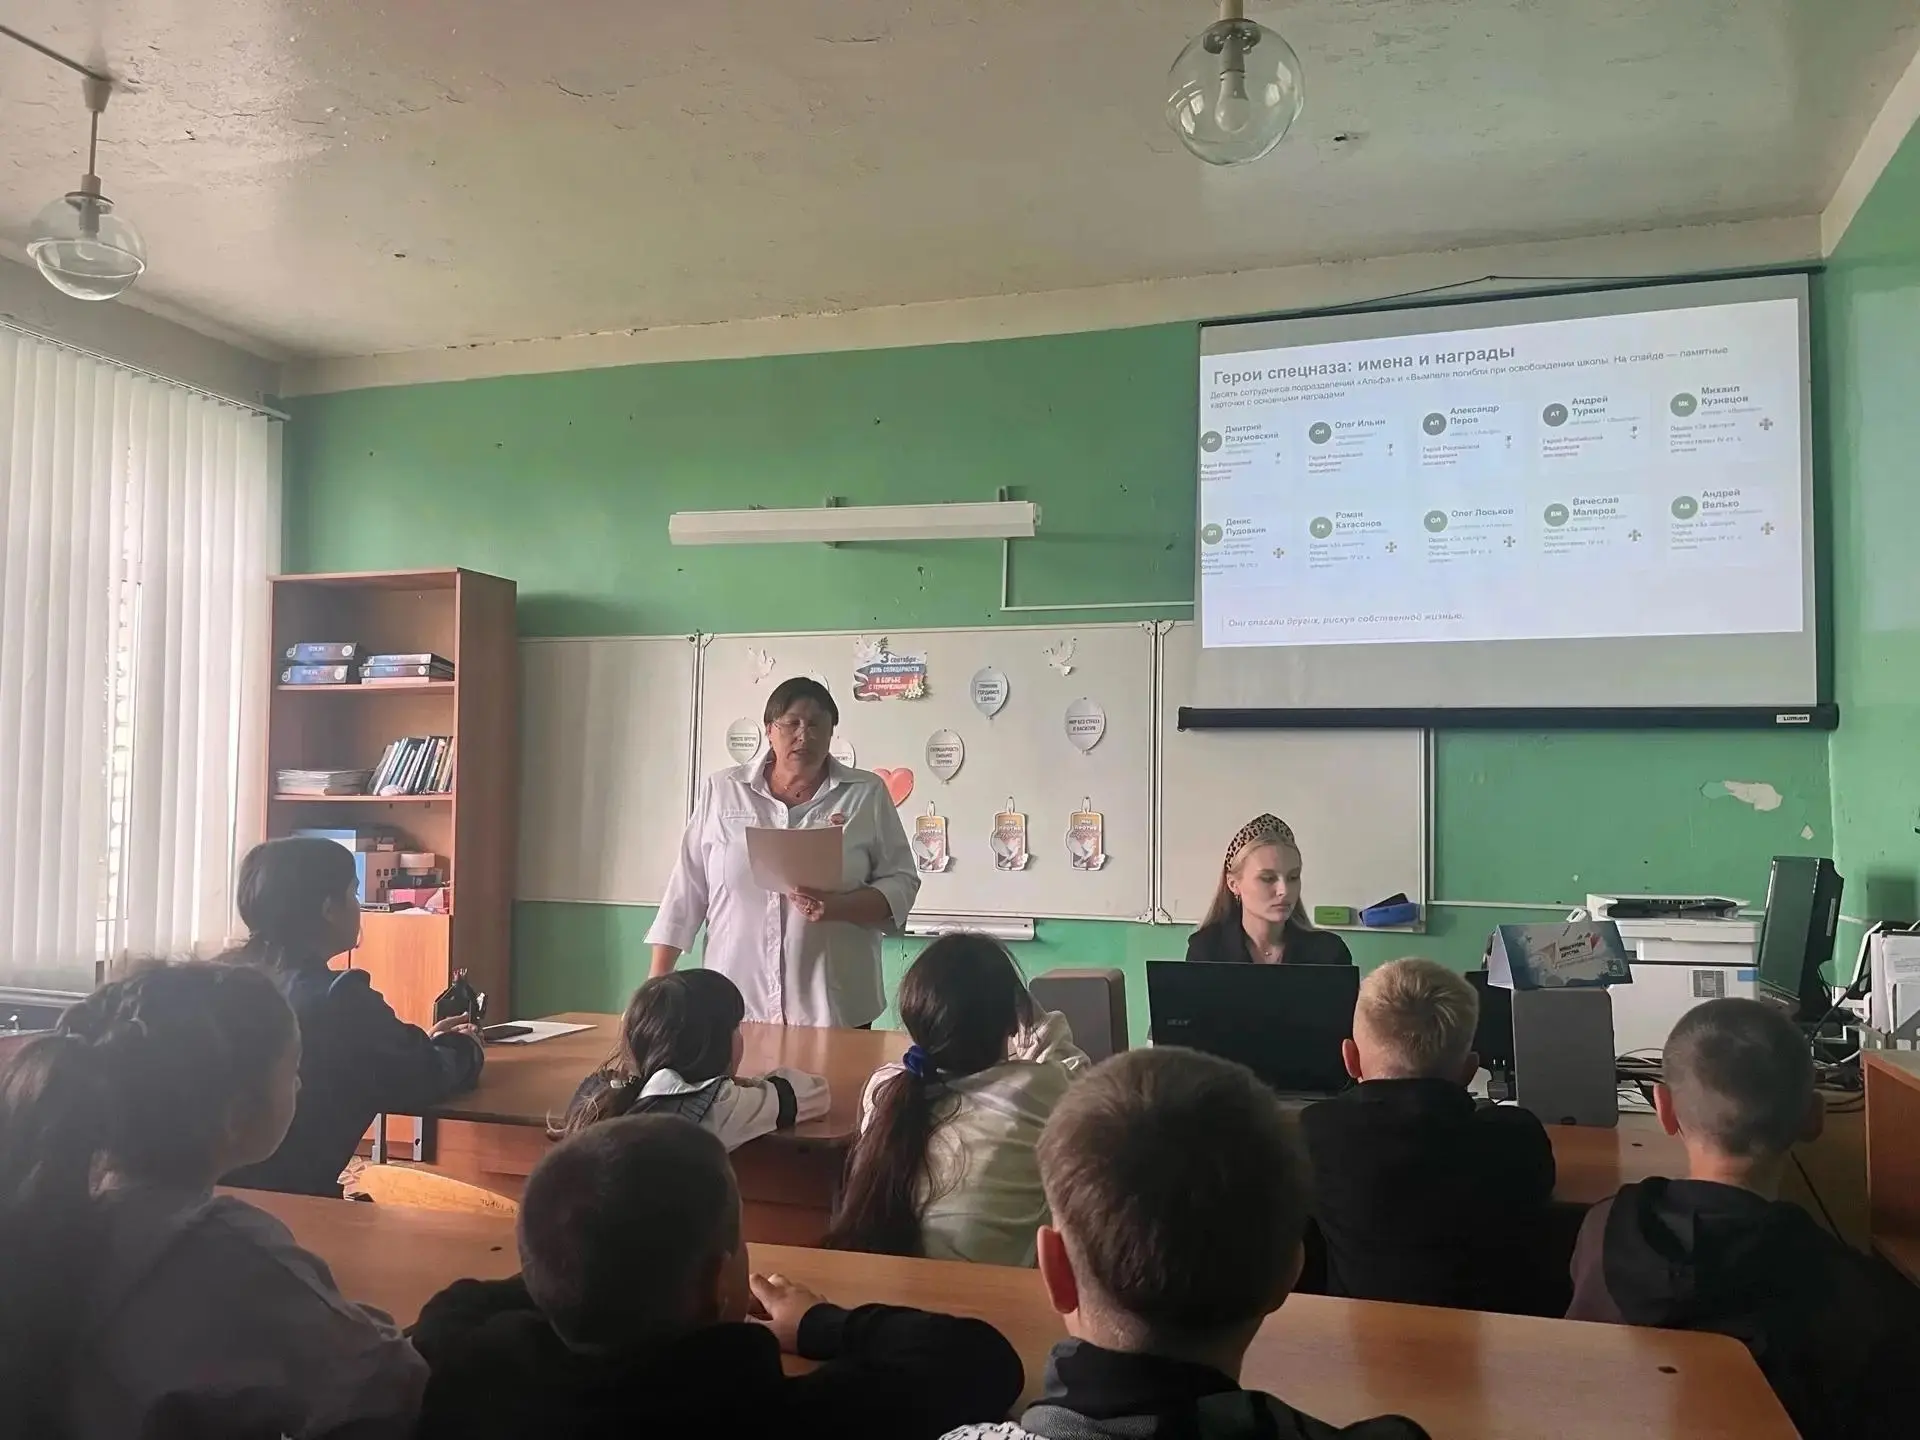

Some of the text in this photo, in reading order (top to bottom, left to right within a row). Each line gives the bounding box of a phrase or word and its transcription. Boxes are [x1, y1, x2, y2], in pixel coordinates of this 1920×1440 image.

[1214, 347, 1515, 386] Герои спецназа: имена и награды
[1210, 391, 1238, 400] Десять
[1240, 386, 1290, 397] сотрудников
[1452, 368, 1488, 378] погибли
[1490, 366, 1506, 376] при
[1508, 358, 1575, 373] освобождении
[1614, 354, 1628, 364] На
[1629, 351, 1664, 363] слайде
[1679, 346, 1729, 358] памятные
[1701, 385, 1741, 395] Михаил
[1210, 400, 1245, 410] карточки
[1253, 394, 1299, 405] основными
[1300, 391, 1346, 402] наградами
[1571, 396, 1608, 406] Андрей
[1701, 395, 1749, 407] Кузнецов
[1449, 404, 1500, 415] Александр
[1571, 406, 1606, 417] Туркин
[1335, 419, 1386, 430] Олег Ильин
[1450, 416, 1479, 425] Перов
[1225, 424, 1262, 434] Дмитрий
[1225, 433, 1279, 443] Разумовский
[1702, 488, 1741, 499] Андрей
[1572, 496, 1619, 506] Вячеслав
[1702, 500, 1740, 509] Велько
[1335, 511, 1363, 519] Роман
[1451, 508, 1514, 518] Олег Лоськов
[1572, 507, 1617, 518] Маляров
[1225, 518, 1251, 527] Денис
[1335, 521, 1382, 529] Катасонов
[1225, 527, 1267, 537] Пудовкин
[1228, 618, 1246, 628] Они
[1247, 618, 1285, 627] спасали
[1322, 616, 1355, 625] рискуя
[1357, 612, 1423, 624] собственной
[880, 653, 889, 664] 3
